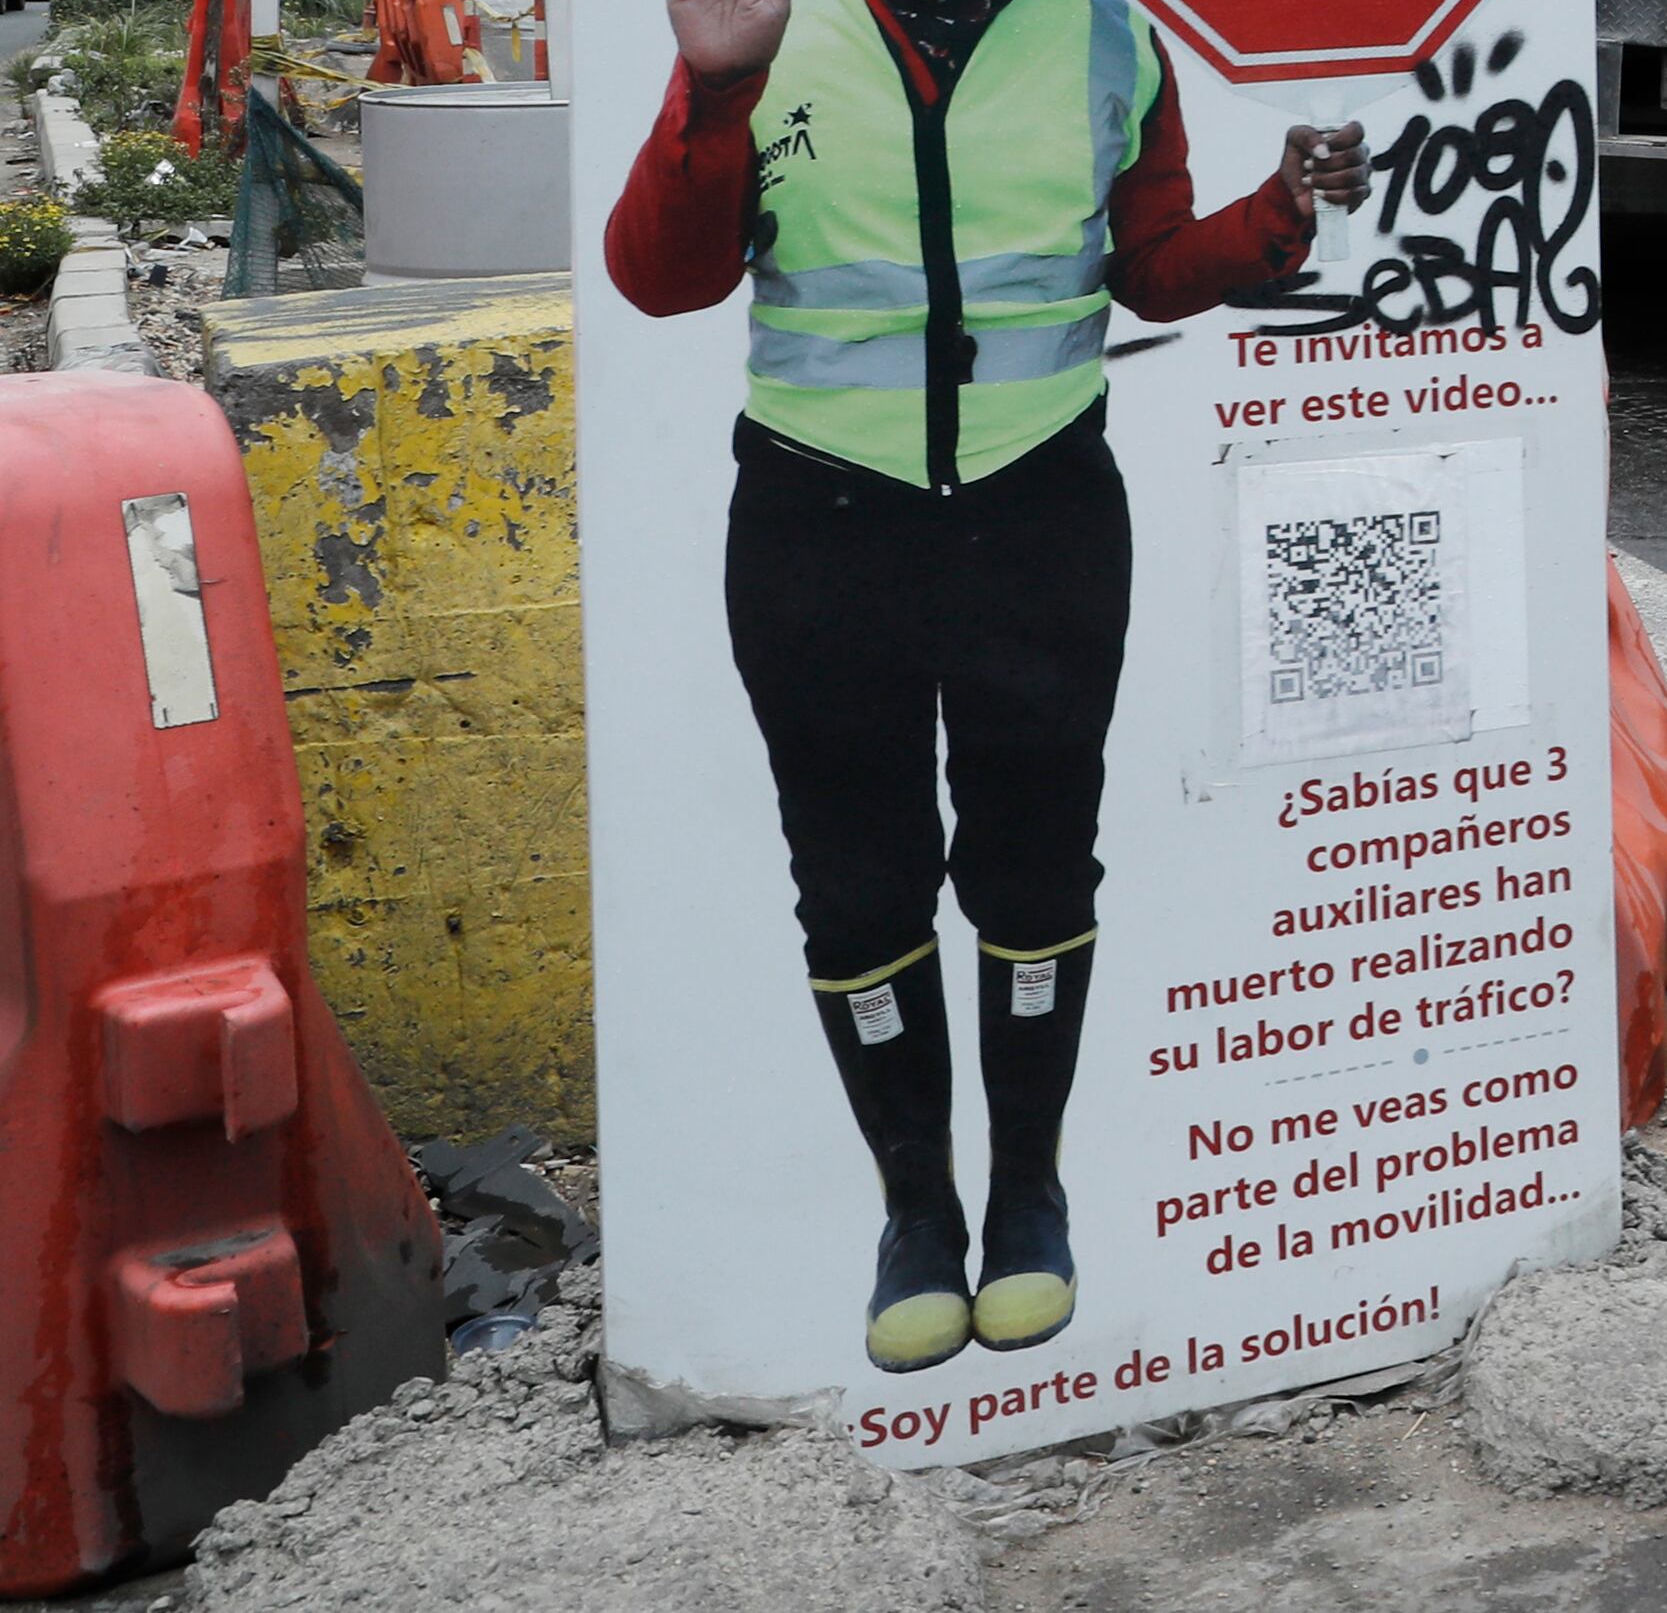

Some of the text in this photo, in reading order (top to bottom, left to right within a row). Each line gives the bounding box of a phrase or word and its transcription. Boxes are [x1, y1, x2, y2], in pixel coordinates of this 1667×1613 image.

[1229, 323, 1543, 367] Te invitamos a
[1215, 375, 1558, 428] ver este video...
[1278, 746, 1568, 828] ¿Sabías que 3
[1307, 810, 1571, 873] compañeros
[1272, 865, 1572, 937] auxiliares han
[1166, 916, 1573, 1013] muerto realizando
[1149, 969, 1575, 1076] su labor de tráfico?
[1188, 1063, 1579, 1161] No me veas como
[1155, 1118, 1580, 1237] parte del problema
[1205, 1172, 1581, 1275] de la movilidad...
[969, 1369, 1098, 1433] parte
[1113, 1348, 1171, 1391] de
[1187, 1338, 1226, 1373] la
[1240, 1286, 1441, 1363] solución!
